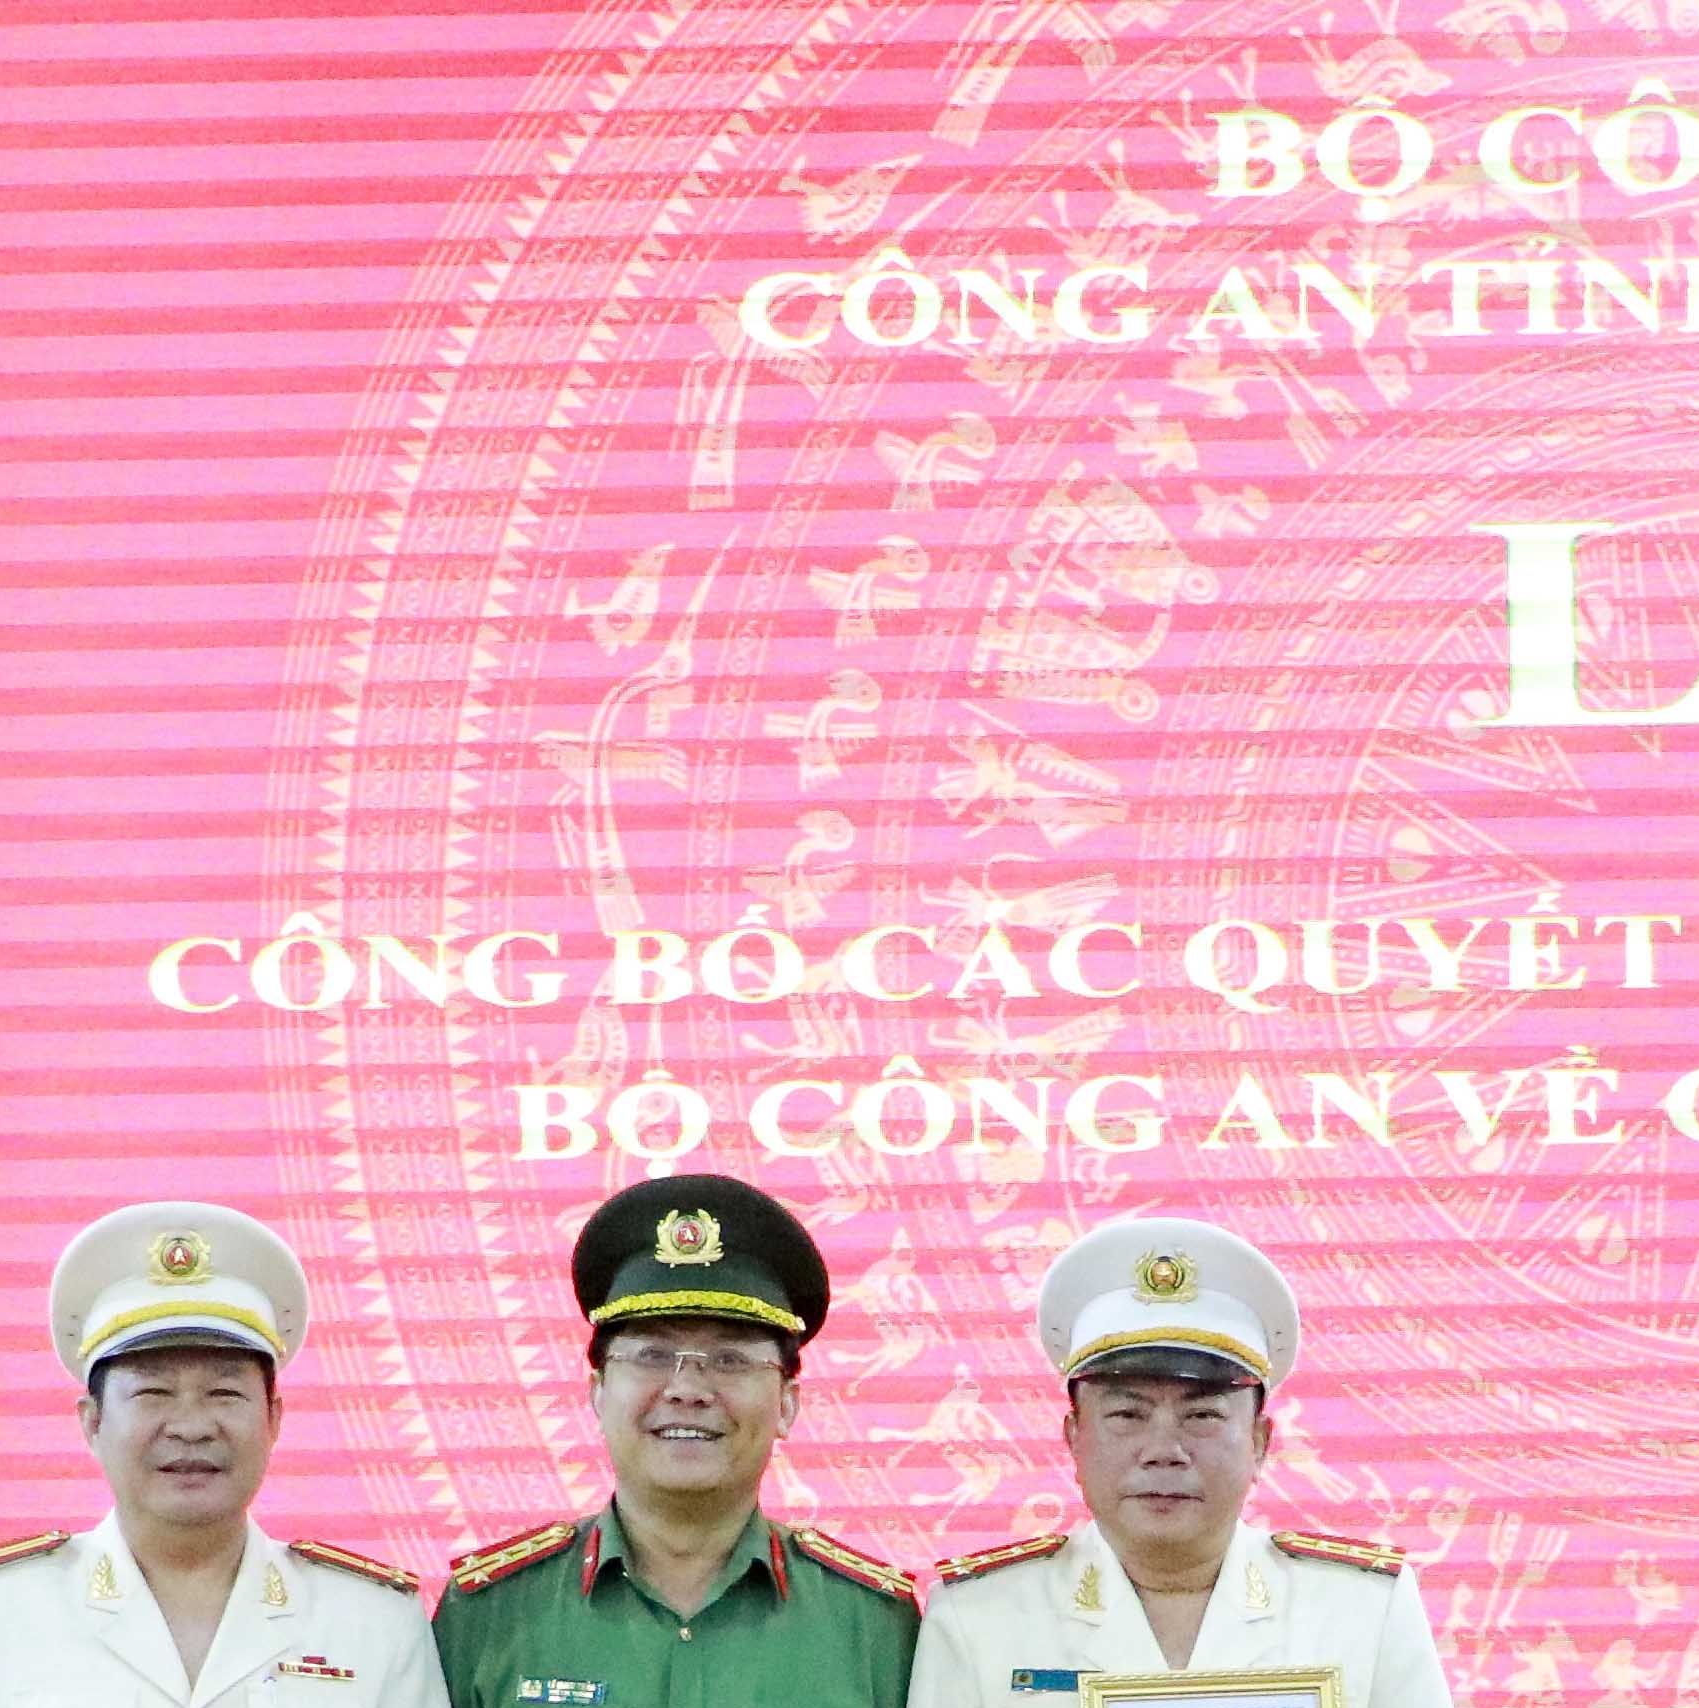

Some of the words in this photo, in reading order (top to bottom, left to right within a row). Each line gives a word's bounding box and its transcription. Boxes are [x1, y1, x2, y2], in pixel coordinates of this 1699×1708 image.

[1205, 97, 1434, 222] BỘ
[739, 246, 1155, 350] CÔNG
[1186, 262, 1396, 341] AN
[148, 911, 569, 1014] CÔNG
[606, 903, 804, 1004] BỐ
[841, 896, 1143, 1001] CÁC
[1183, 892, 1684, 1014] QUYẾT
[511, 1068, 711, 1180] BỘ
[747, 1054, 1168, 1157] CÔNG
[1197, 1072, 1395, 1149] AN
[1432, 1044, 1624, 1146] VỀ
